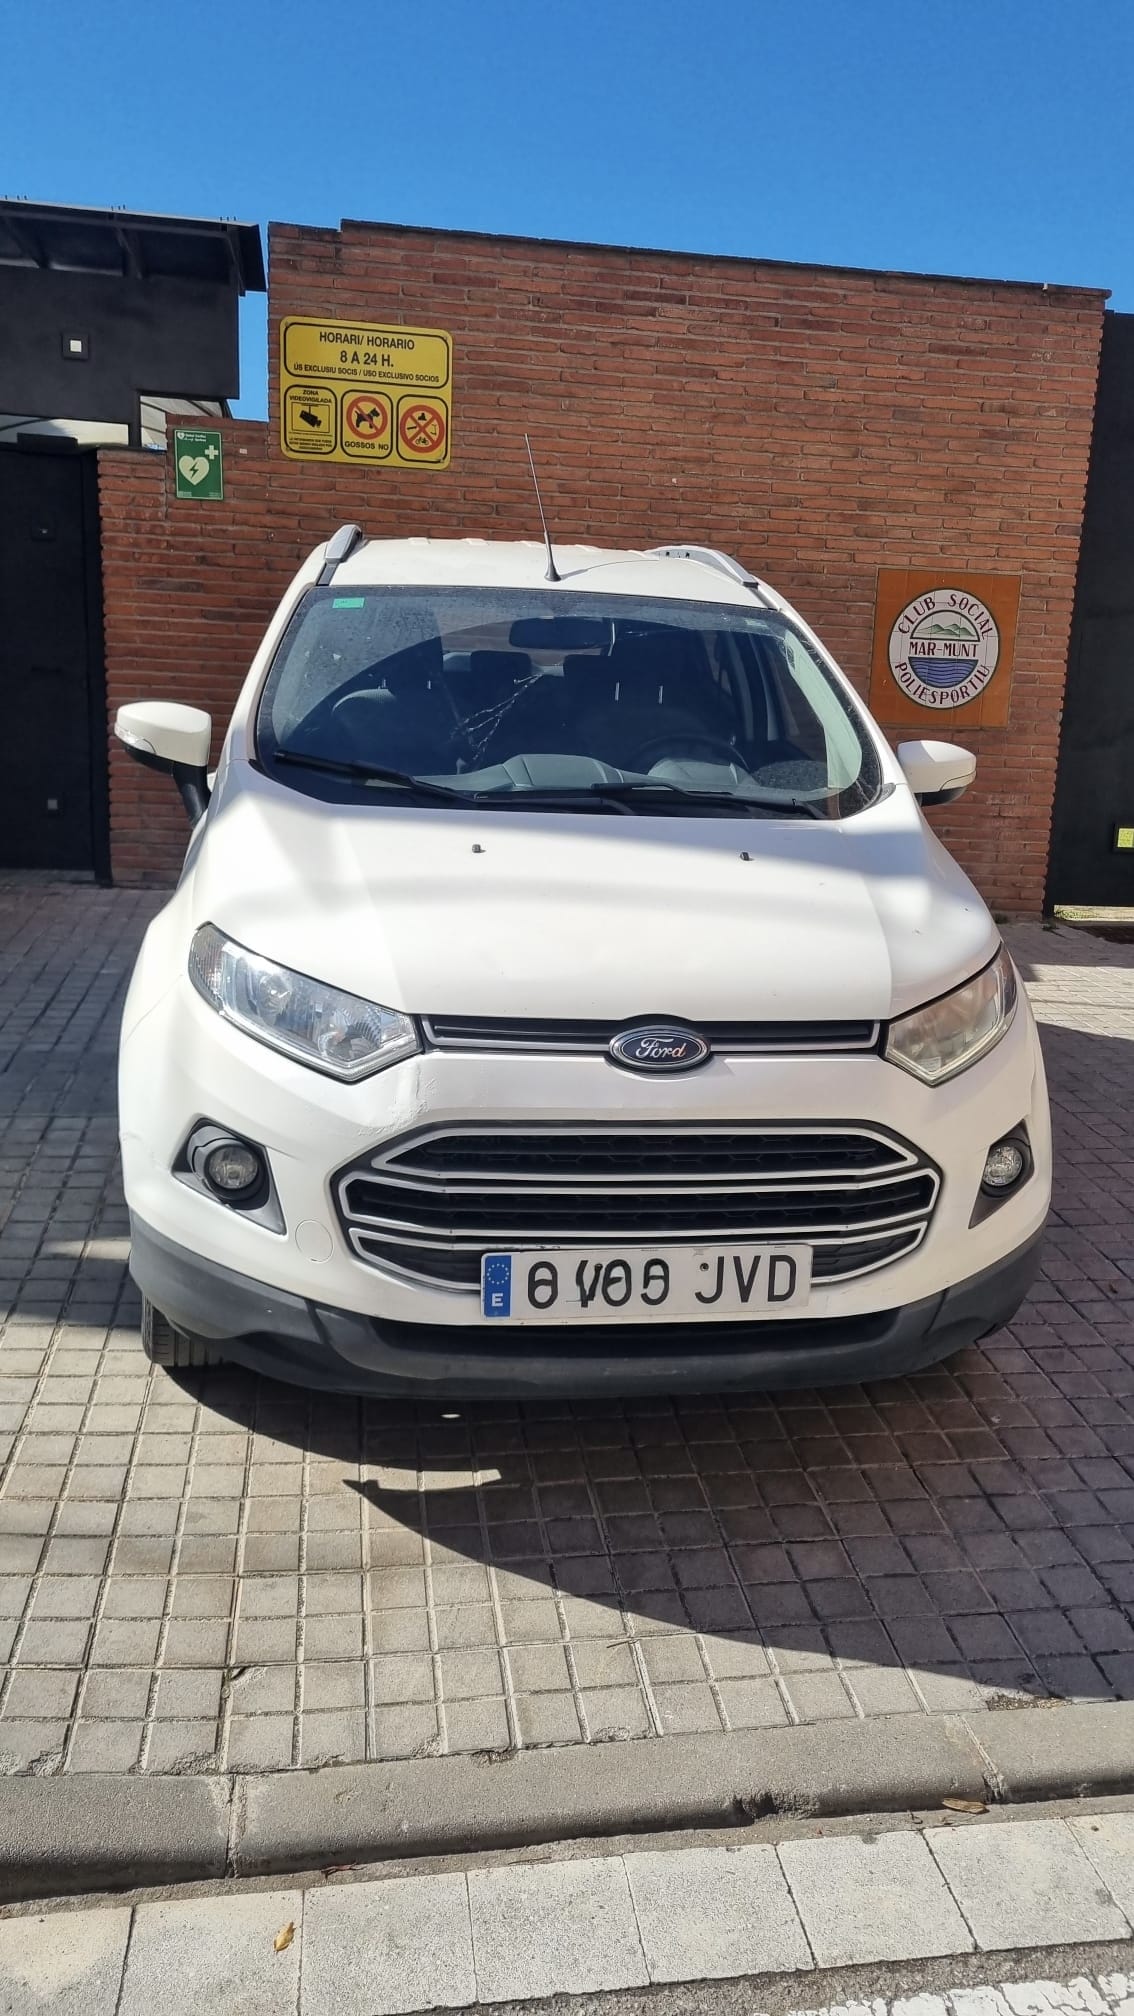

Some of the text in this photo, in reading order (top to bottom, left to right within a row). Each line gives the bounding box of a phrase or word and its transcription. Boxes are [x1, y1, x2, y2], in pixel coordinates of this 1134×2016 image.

[319, 331, 415, 351] HORARI/ HORARIO
[340, 350, 394, 368] 8 A 24 H.
[304, 364, 337, 374] EXCLUSIU
[337, 367, 358, 376] SOCIS
[363, 369, 377, 377] USO
[378, 371, 414, 381] EXCLUSIVO
[415, 374, 440, 383] SOCIOS
[344, 440, 389, 451] GOSSOS NO
[898, 593, 993, 640] CLUB SOCIAL
[908, 641, 979, 658] MAR-MUNT
[894, 662, 990, 705] POLIESPORTIU
[635, 1037, 687, 1058] Ford
[694, 1254, 797, 1304] JVD
[491, 1293, 503, 1307] E
